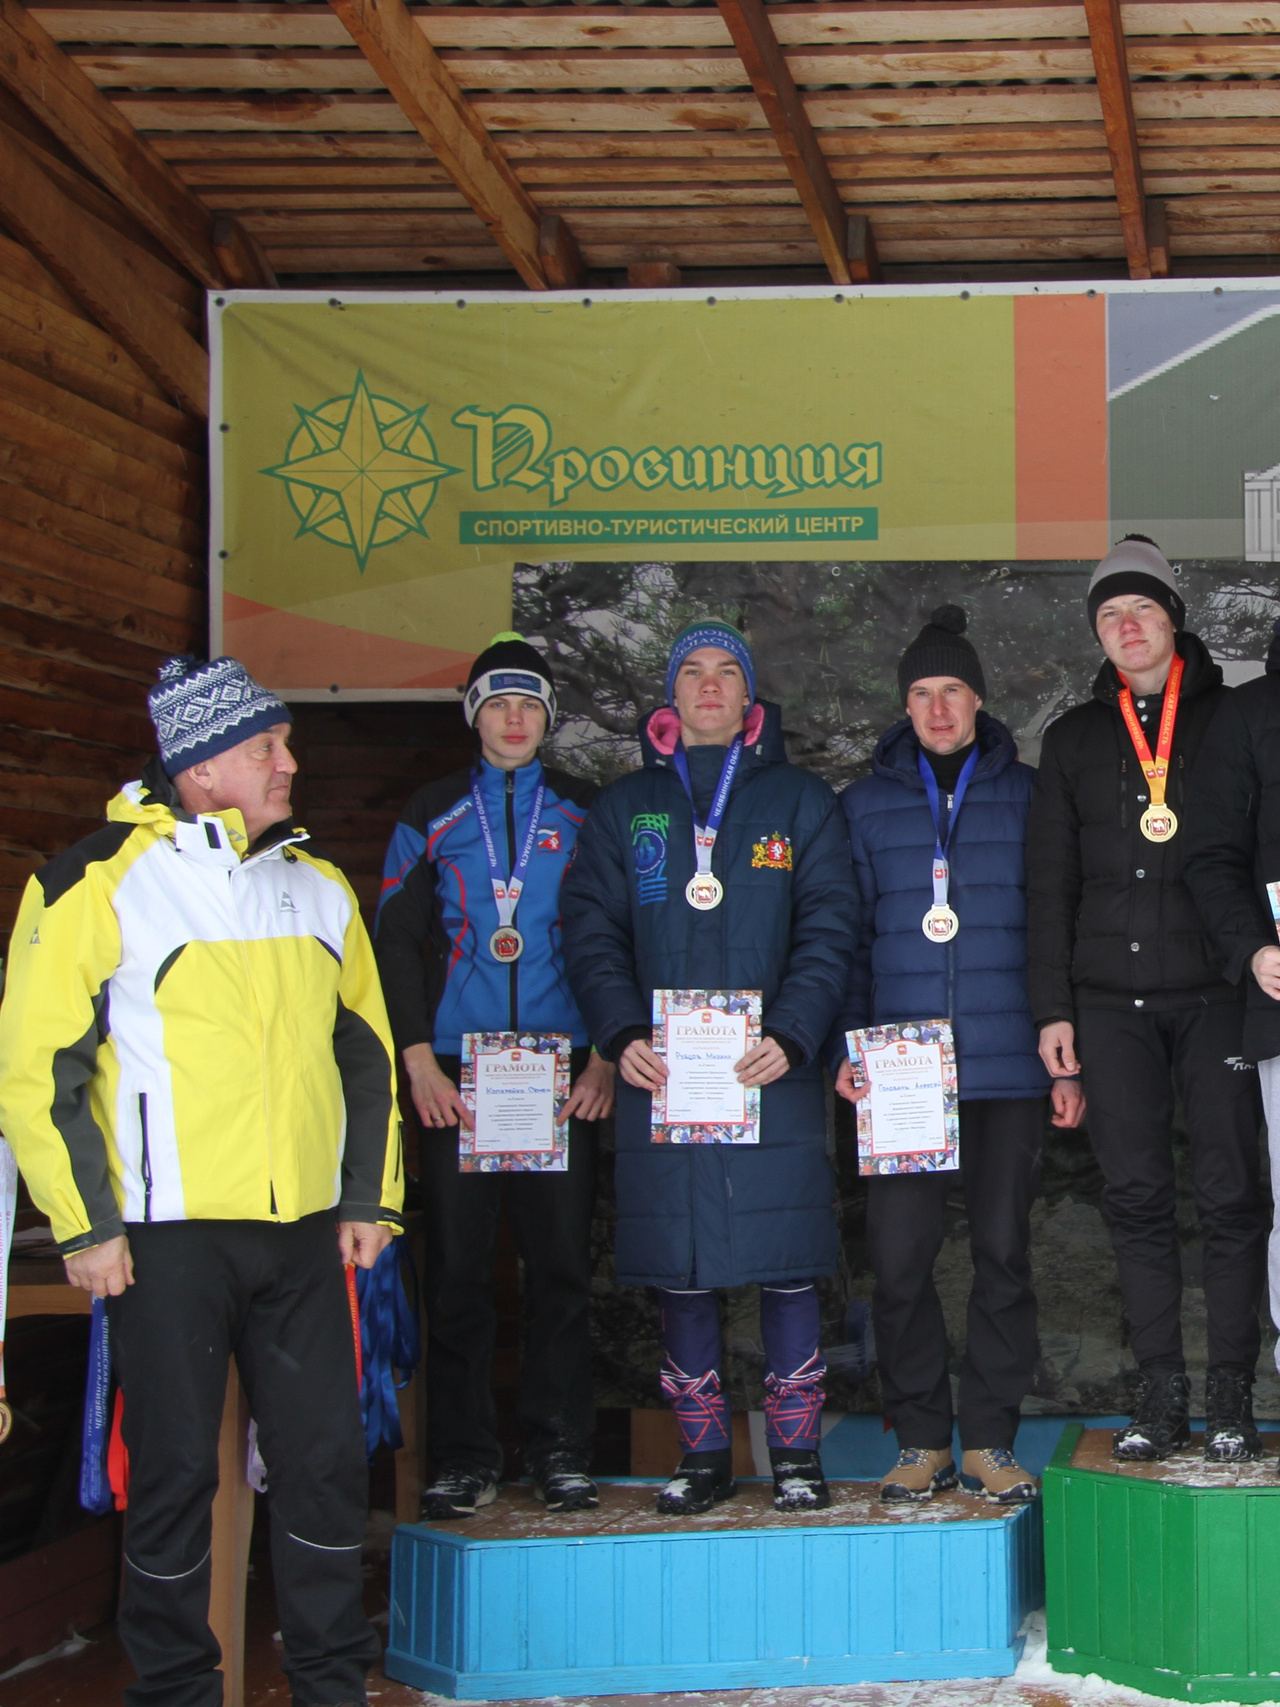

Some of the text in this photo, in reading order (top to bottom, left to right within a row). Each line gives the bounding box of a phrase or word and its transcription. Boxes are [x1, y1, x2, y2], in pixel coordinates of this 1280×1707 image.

[452, 404, 882, 507] Провинция
[474, 514, 864, 537] СПОРТИВНО-ТУРИСТИЧЕСКИЙ ЦЕНТР
[1121, 696, 1145, 750] ЧЕЛЯБИНСКАЯ
[1161, 709, 1172, 745] ОБЛАСТЬ
[713, 764, 736, 818] ЧЕЛЯБИНСКАЯ
[471, 783, 498, 867] ЧЕЛЯБИНСКАЯ ОБЛАСТЬ
[518, 784, 544, 868] ЧЕЛЯБИНСКАЯ ОБЛАСТЬ
[676, 1026, 737, 1036] ГРАМОТА
[485, 1064, 546, 1073] ГРАМОТА
[874, 1056, 933, 1069] ГРАМОТА
